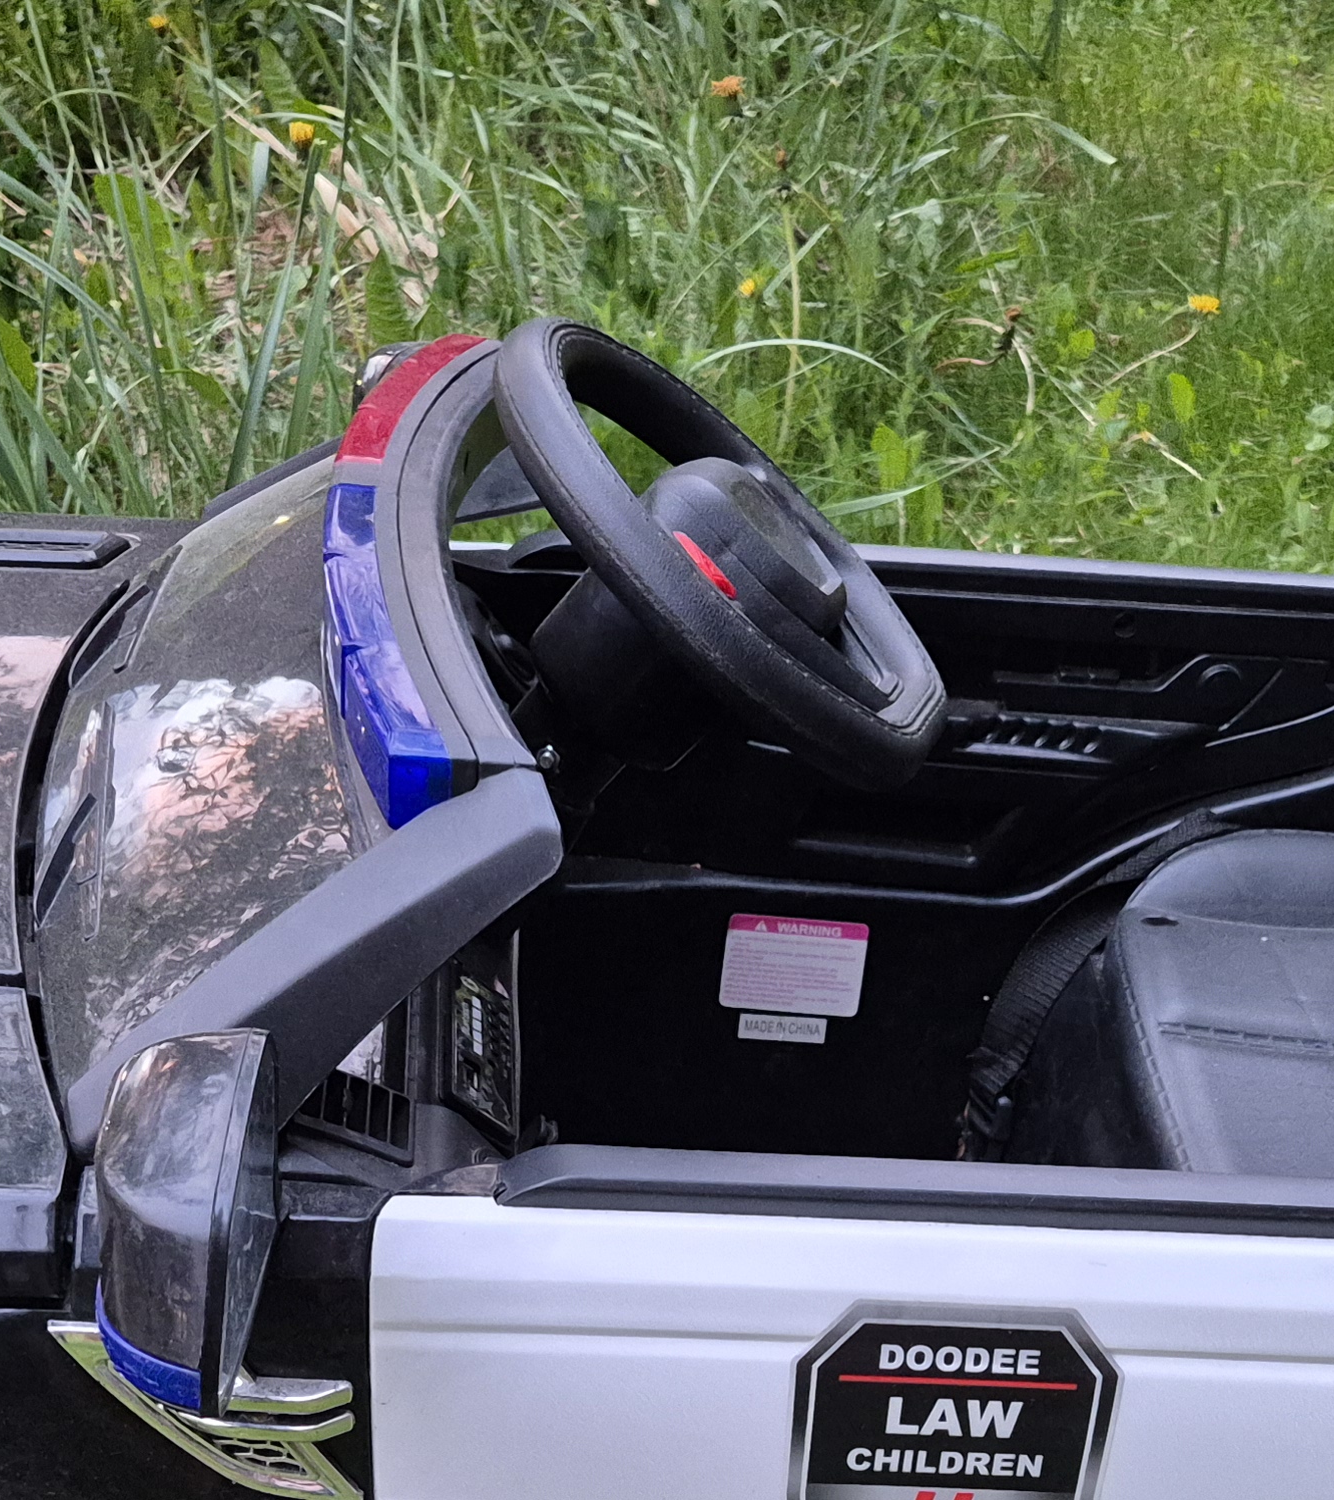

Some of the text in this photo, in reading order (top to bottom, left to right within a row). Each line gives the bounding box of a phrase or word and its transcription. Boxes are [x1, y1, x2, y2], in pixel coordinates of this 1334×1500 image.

[777, 921, 843, 937] WARNING
[744, 1020, 821, 1036] MADE IN CHINA
[879, 1344, 1042, 1375] DOODEE
[885, 1396, 1023, 1439] LAW
[846, 1447, 1043, 1478] CHILDREN
